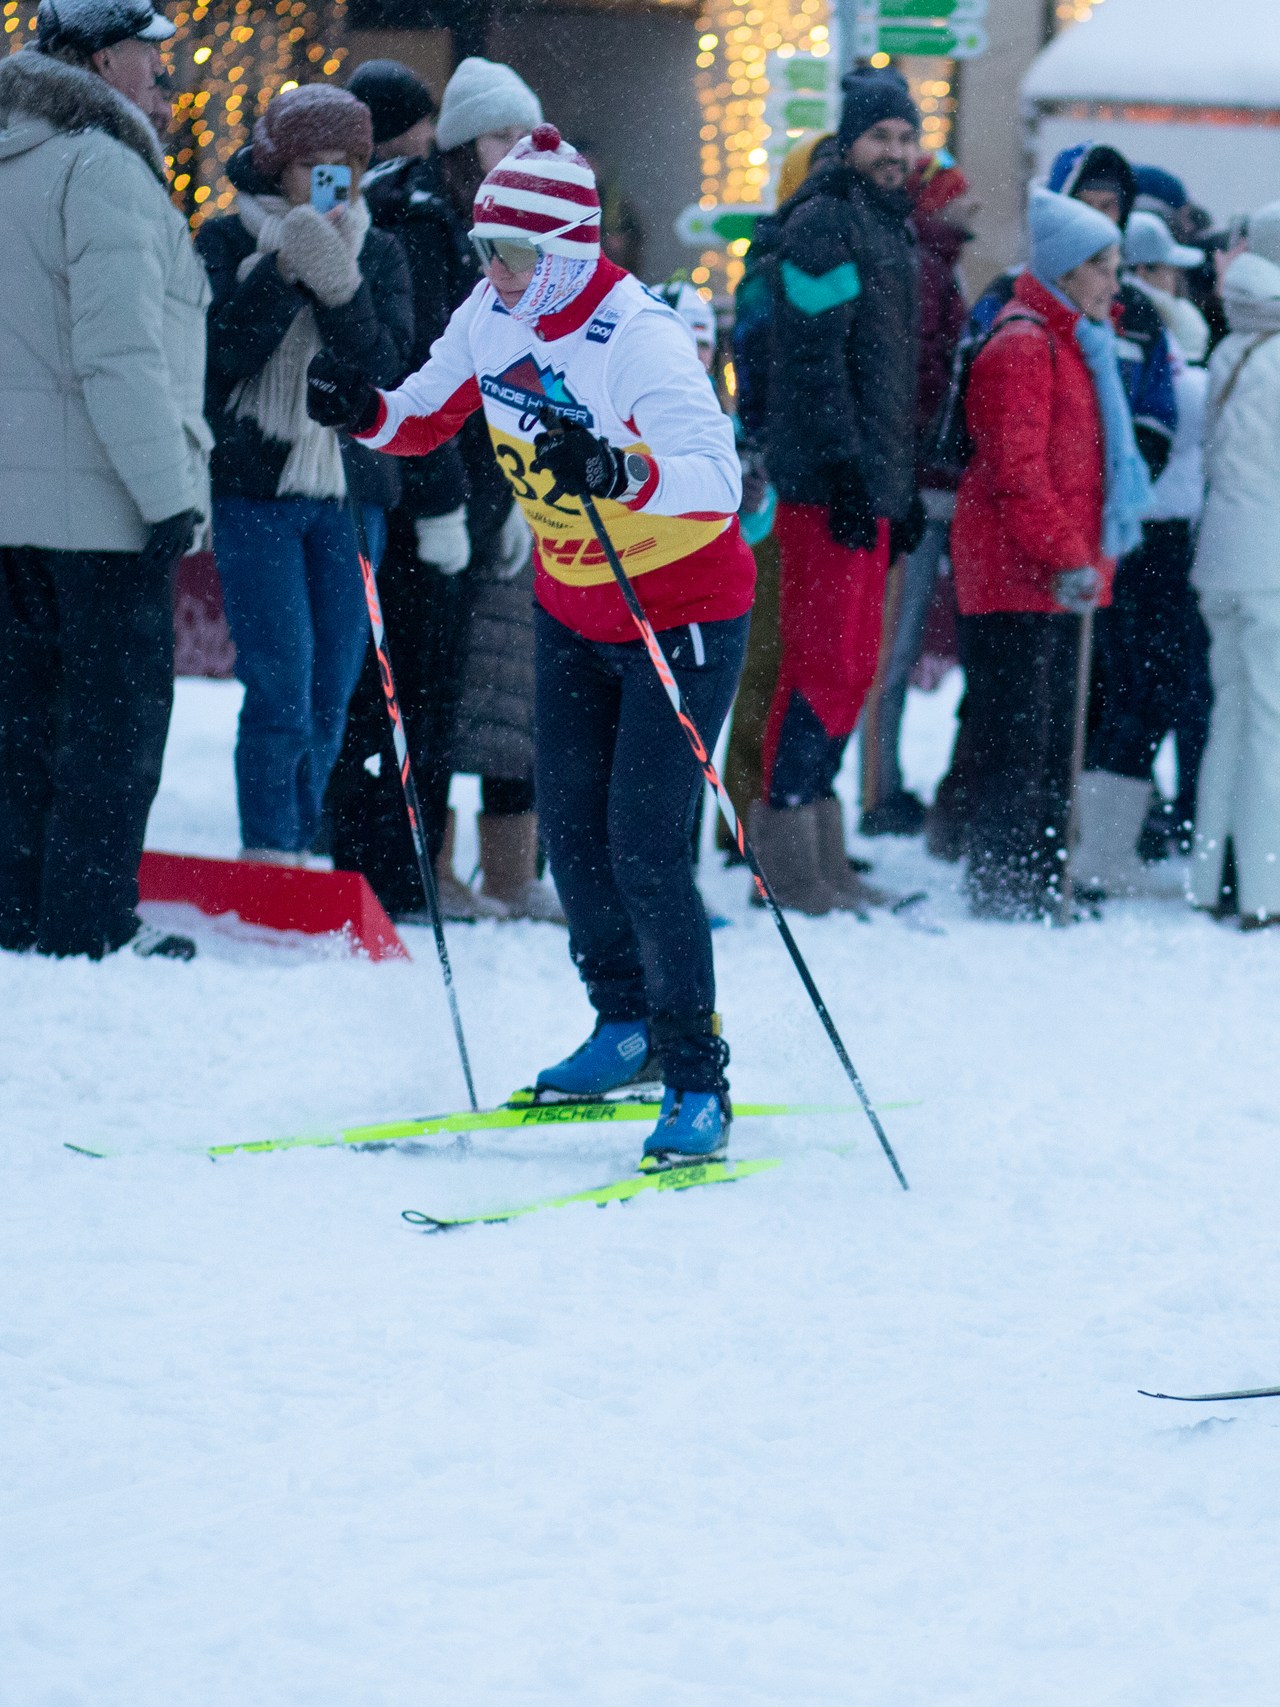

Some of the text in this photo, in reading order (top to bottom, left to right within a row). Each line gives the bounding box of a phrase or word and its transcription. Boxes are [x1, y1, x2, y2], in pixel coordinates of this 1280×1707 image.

[482, 379, 527, 405] TINDE
[521, 1105, 617, 1123] FISCHER
[658, 1167, 707, 1187] FISCHER
